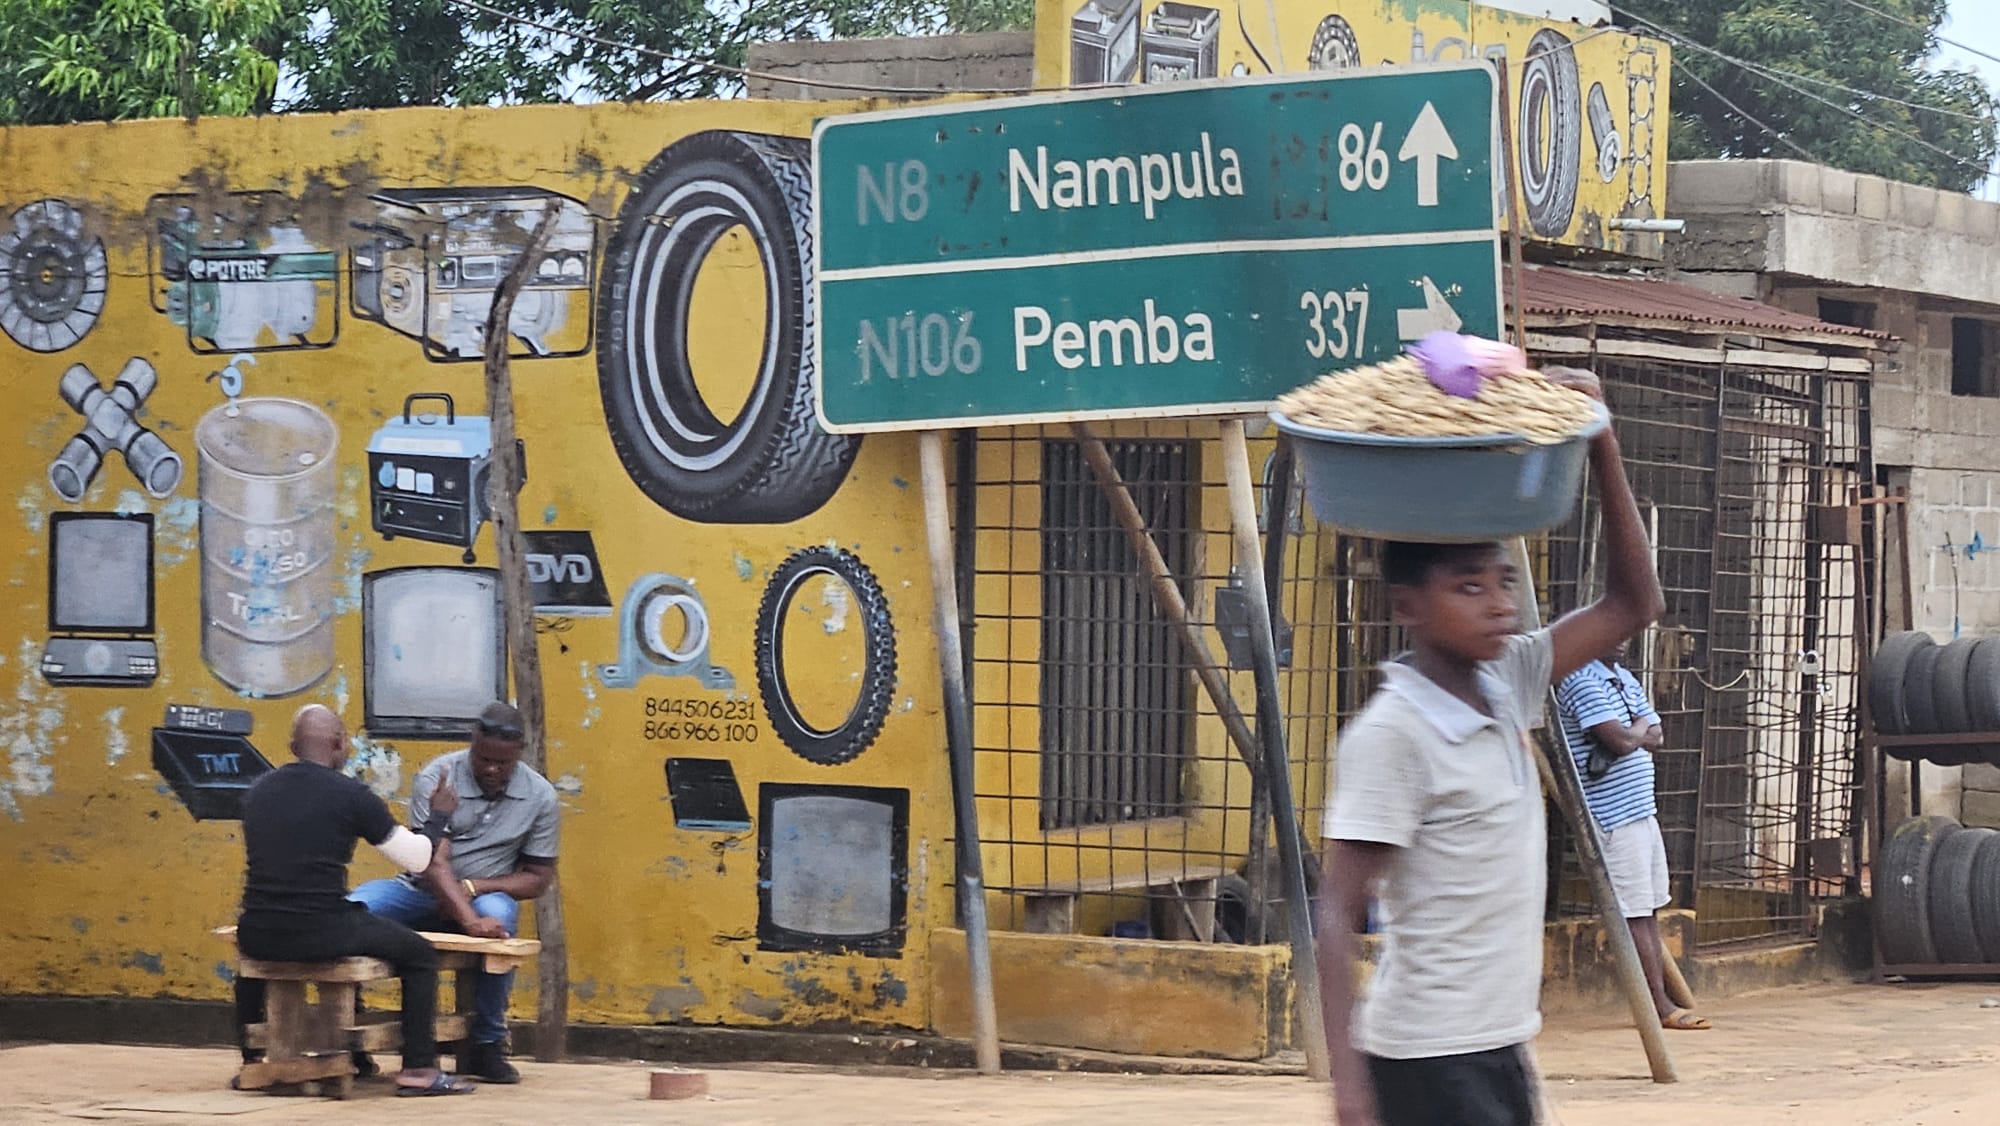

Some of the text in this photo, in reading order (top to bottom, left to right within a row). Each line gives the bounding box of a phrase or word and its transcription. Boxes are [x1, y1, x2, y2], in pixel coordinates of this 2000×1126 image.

[857, 121, 1390, 226] N8 Nampula 86
[858, 290, 1370, 382] N106 Pemba 337
[524, 553, 593, 583] DVD
[645, 697, 755, 720] 844506231
[196, 752, 242, 775] TMT
